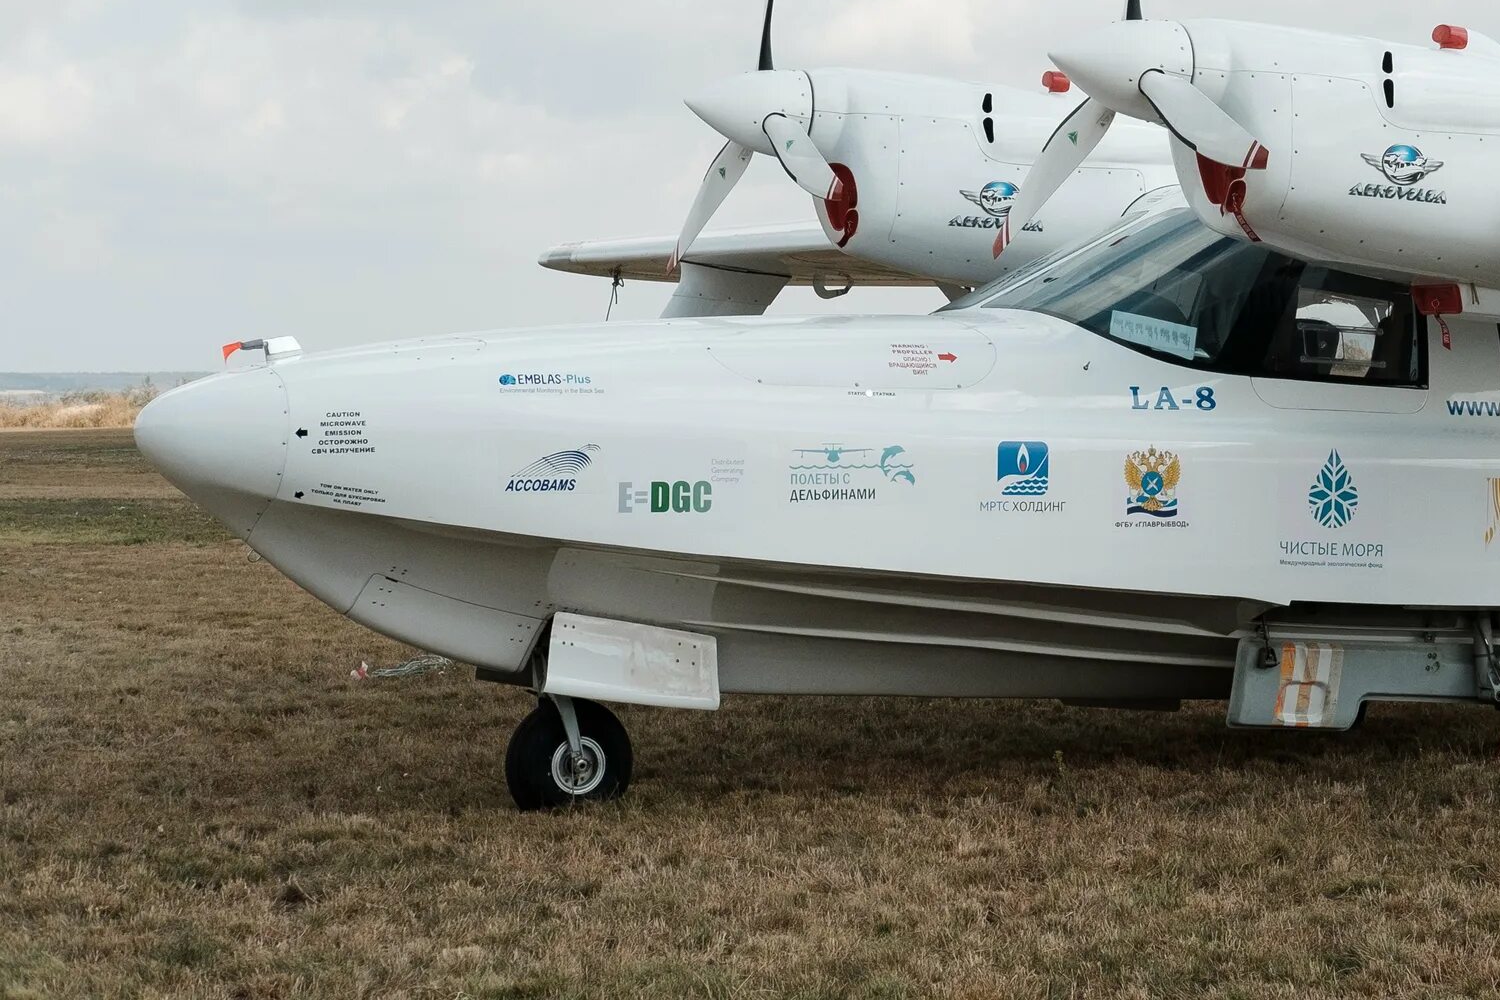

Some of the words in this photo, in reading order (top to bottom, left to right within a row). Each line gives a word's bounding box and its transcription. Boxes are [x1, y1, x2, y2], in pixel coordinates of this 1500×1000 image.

[1348, 182, 1447, 204] AEROVOLGA
[517, 374, 592, 385] EMBLAS-Plus
[1129, 386, 1216, 411] LA-8
[504, 479, 577, 492] ACCOBAMS
[790, 473, 839, 485] ПОЛЕТЫ
[348, 494, 385, 503] БУКСИРОВКИ
[618, 480, 713, 513] E=DGC
[789, 488, 876, 503] ДЕЛЬФИНАМИ
[979, 501, 1009, 512] МРТС
[1012, 501, 1066, 513] ХОЛДИНГ
[1280, 541, 1338, 556] ЧИСТЫЕ
[1342, 543, 1383, 557] МОРЯ
[1280, 559, 1326, 567] Международный
